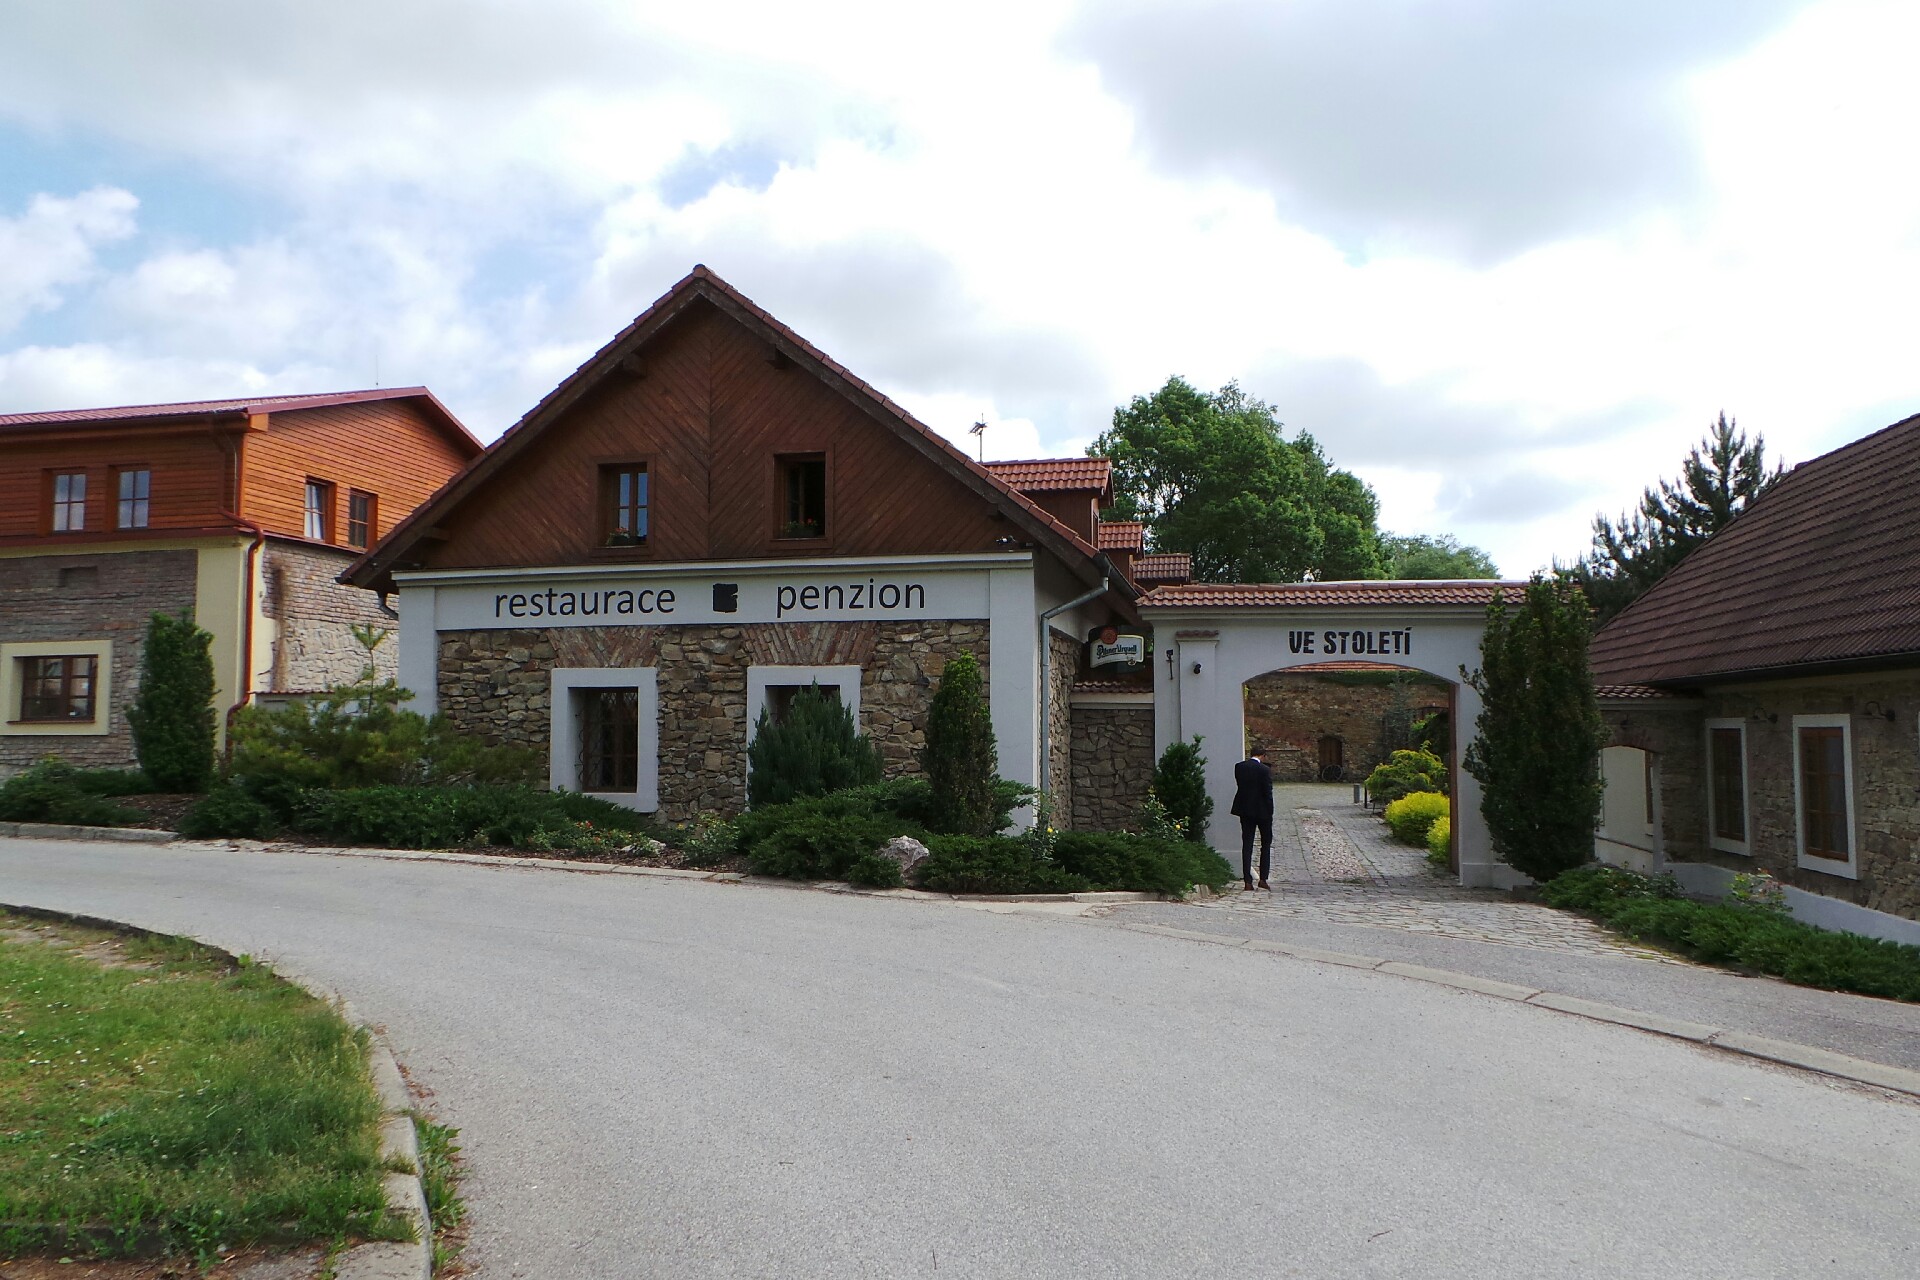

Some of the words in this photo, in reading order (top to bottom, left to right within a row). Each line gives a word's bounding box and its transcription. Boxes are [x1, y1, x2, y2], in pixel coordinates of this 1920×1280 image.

[495, 587, 676, 617] restaurace
[776, 578, 926, 618] penzion
[1097, 645, 1117, 659] Pilsner
[1116, 644, 1137, 655] Urquell
[1289, 631, 1315, 654] VE
[1323, 627, 1412, 655] STOLETÍ
